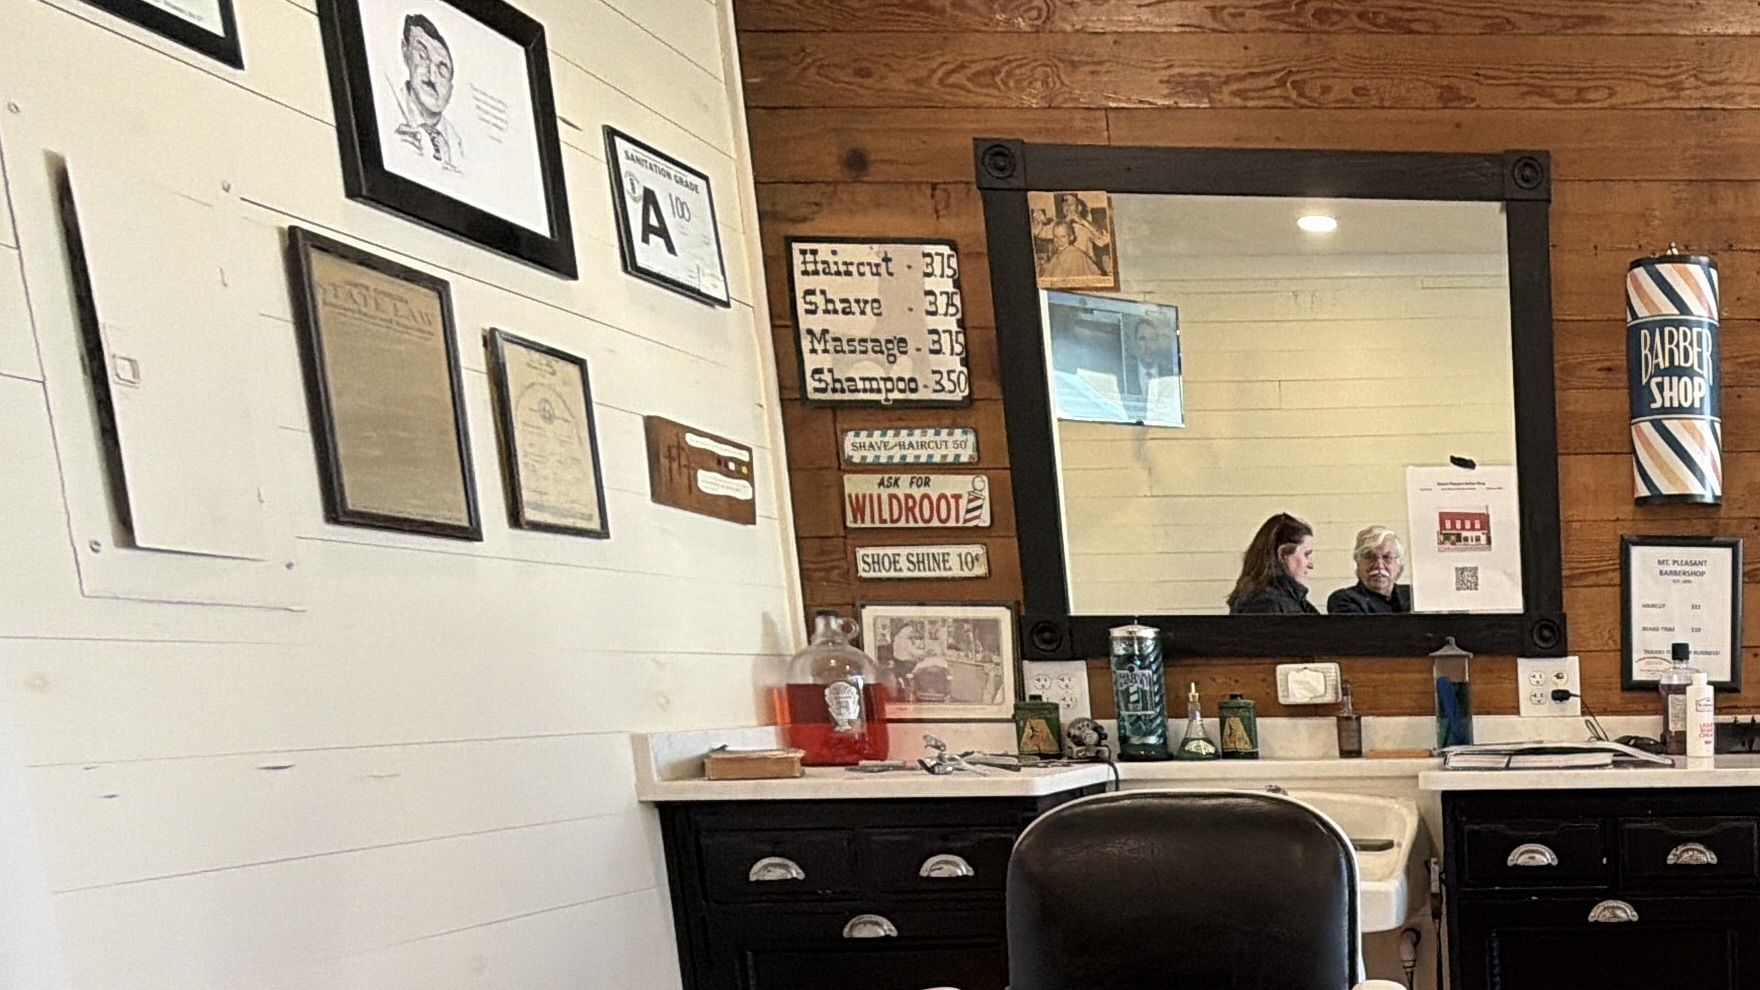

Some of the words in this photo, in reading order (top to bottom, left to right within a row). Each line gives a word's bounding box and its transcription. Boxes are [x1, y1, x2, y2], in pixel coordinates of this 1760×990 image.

[624, 149, 673, 181] SANITATION
[673, 174, 701, 194] GRADE
[640, 185, 679, 258] A
[668, 192, 692, 223] 100
[798, 248, 895, 277] Haircut
[801, 288, 883, 317] Shave
[805, 328, 909, 365] Massage
[1640, 326, 1713, 386] BARBER
[810, 367, 919, 403] Shampoo
[1650, 376, 1707, 409] SHOP
[877, 476, 901, 488] ASK
[909, 476, 931, 488] FOR
[848, 492, 963, 525] WILDROOT
[861, 553, 904, 574] SHOE
[906, 552, 952, 573] SHINE
[1657, 559, 1670, 567] MT.
[1672, 559, 1708, 567] PLEASANT
[1659, 570, 1706, 578] BARBERSHOP
